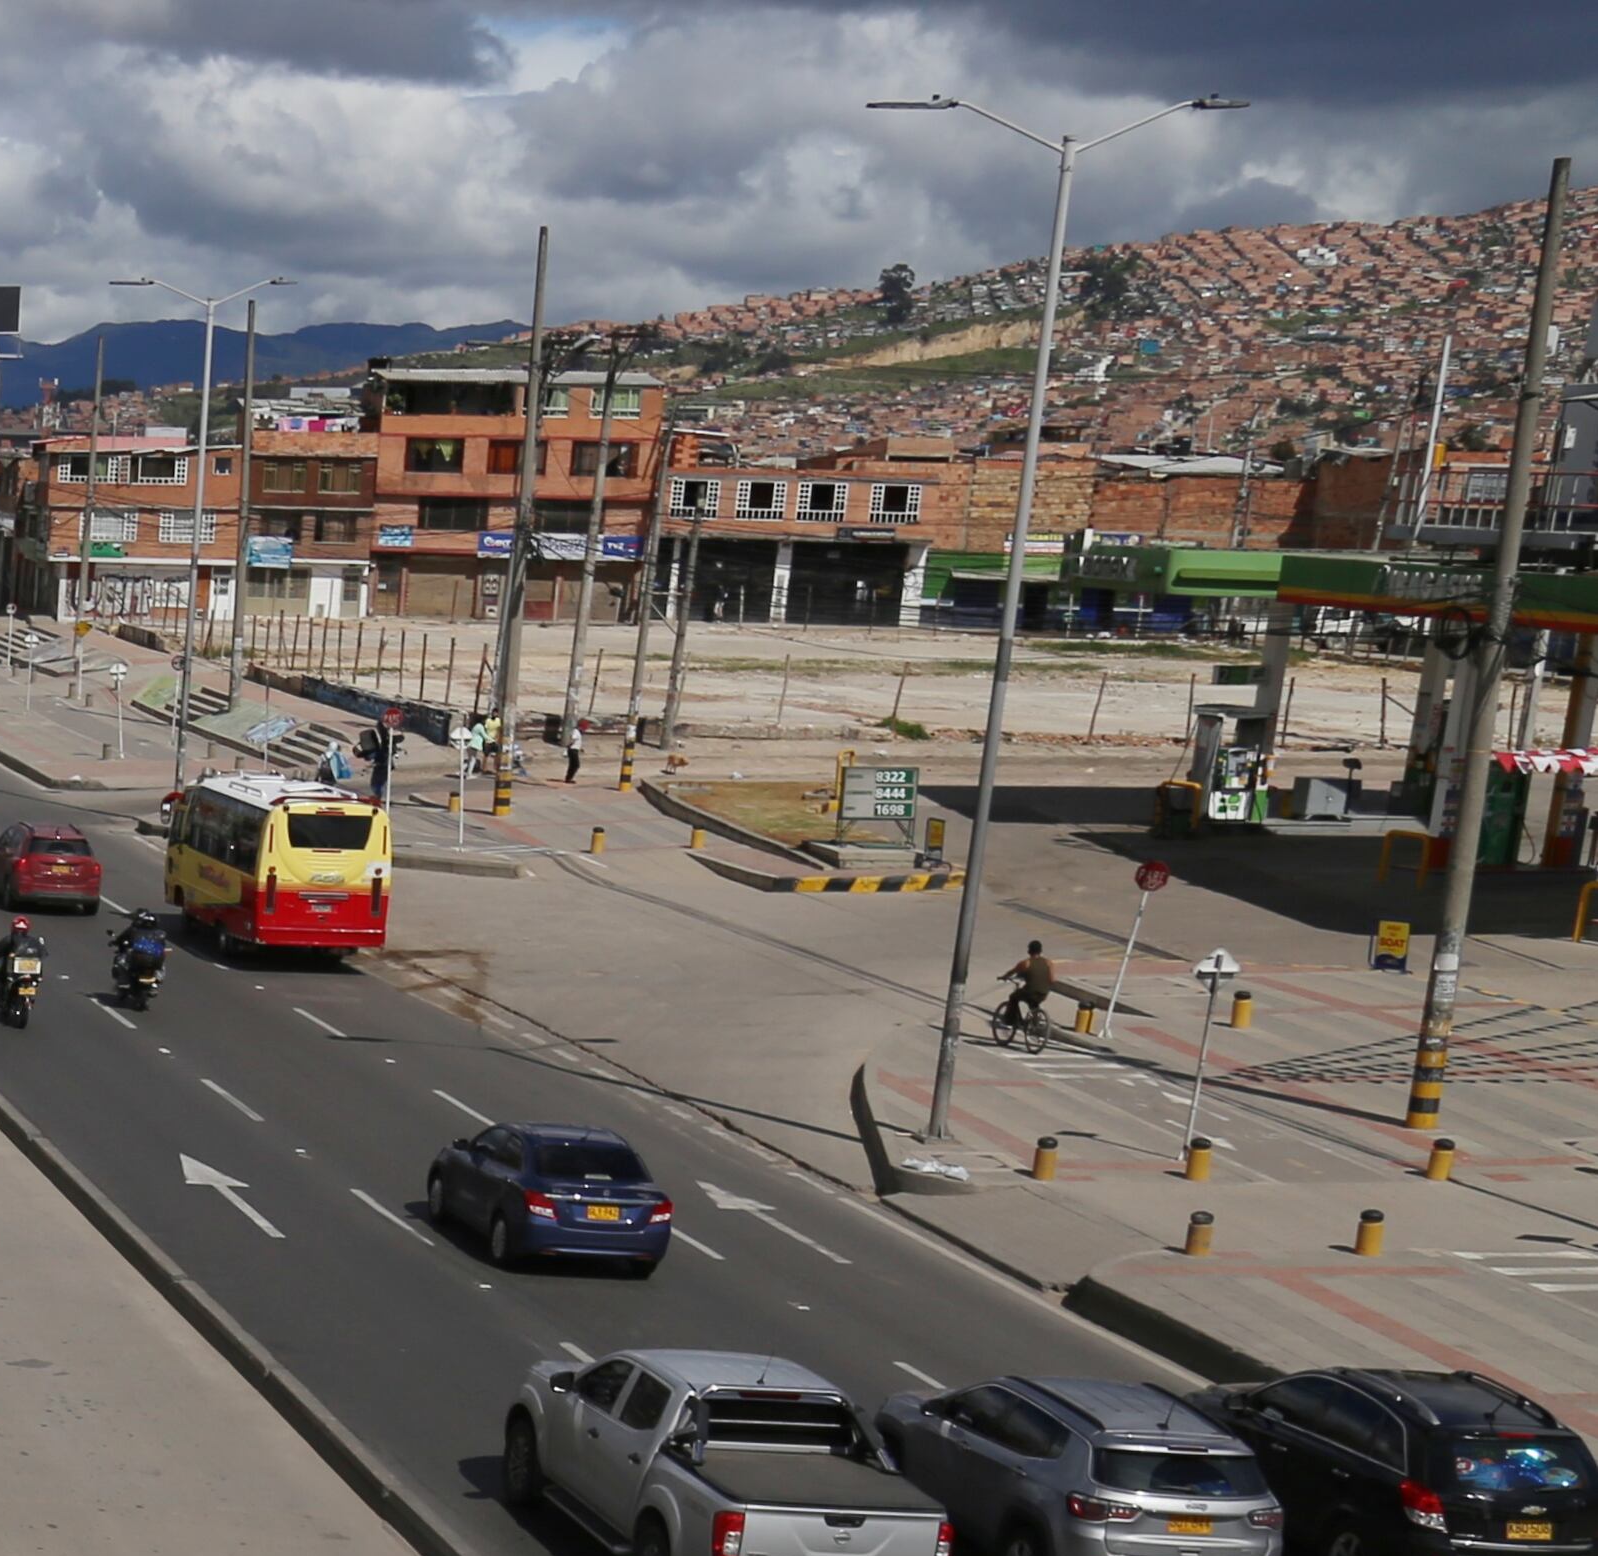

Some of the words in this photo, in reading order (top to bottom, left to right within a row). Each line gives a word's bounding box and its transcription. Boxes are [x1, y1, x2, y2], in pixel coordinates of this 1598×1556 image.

[875, 771, 907, 783] 8322
[874, 787, 906, 799] 8444
[875, 804, 905, 816] 1698
